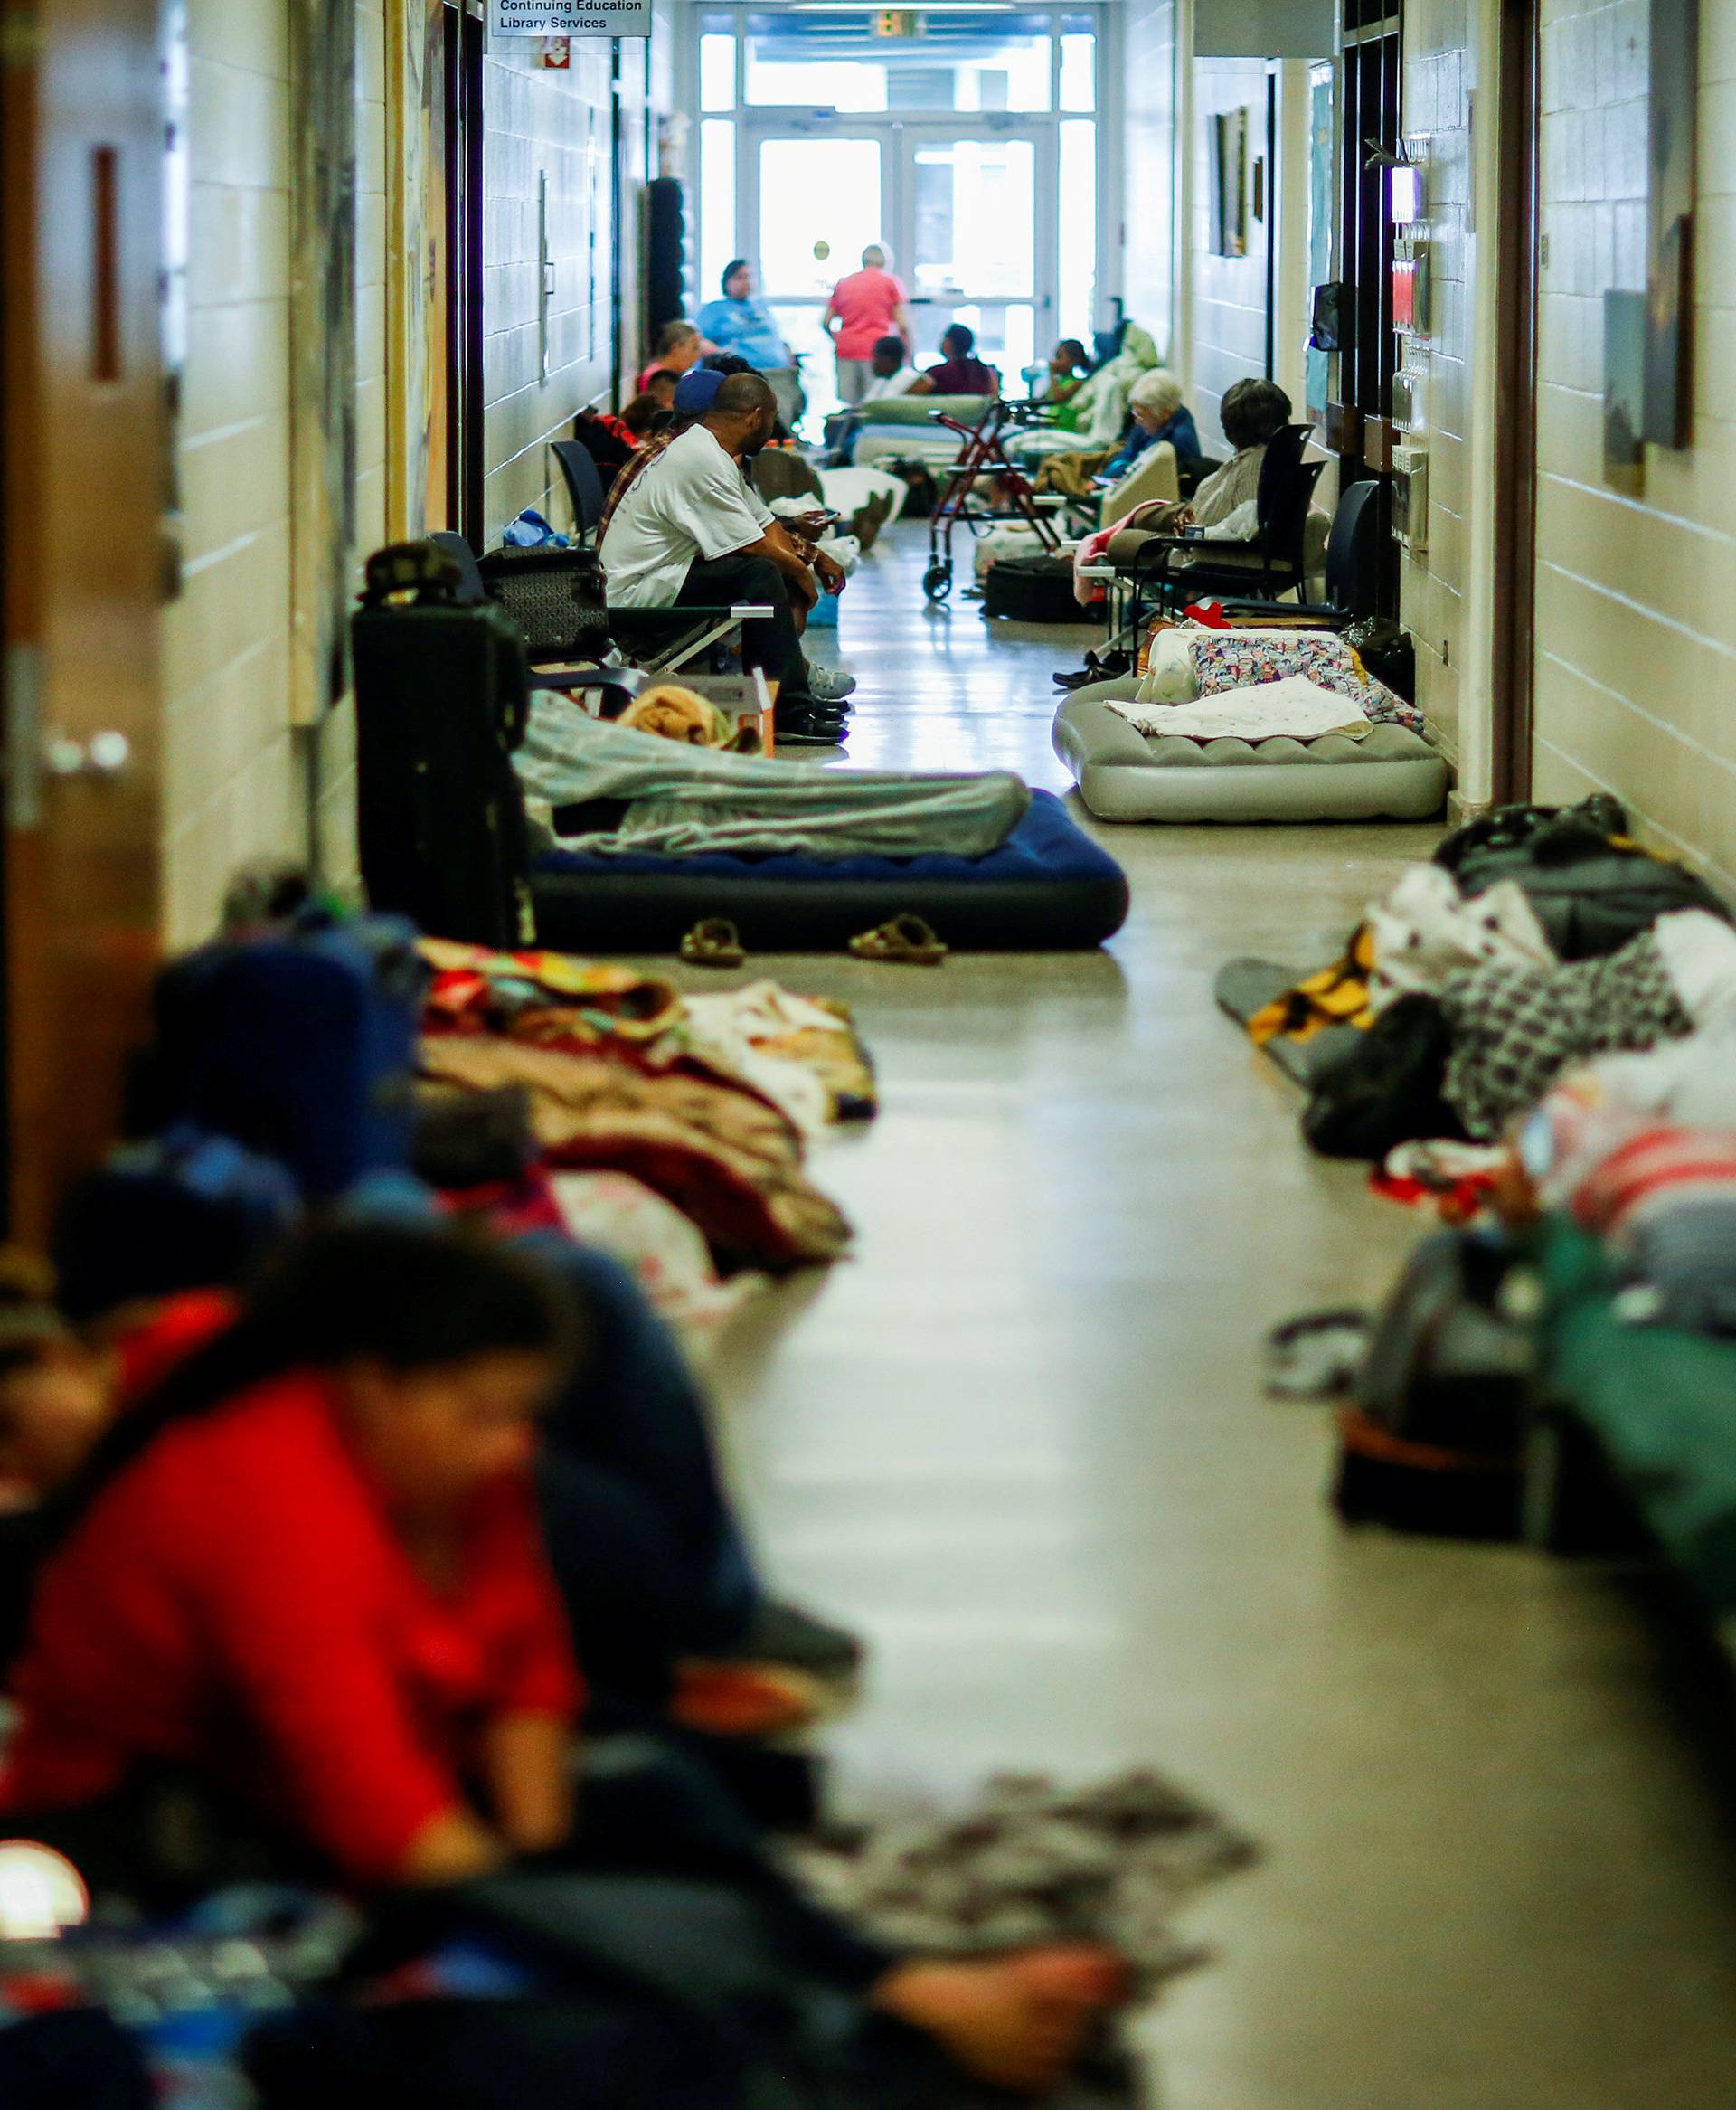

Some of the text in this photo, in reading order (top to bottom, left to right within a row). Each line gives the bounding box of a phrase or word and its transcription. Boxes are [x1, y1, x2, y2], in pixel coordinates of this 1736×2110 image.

[500, 0, 642, 13] Continuing Education
[500, 17, 607, 31] Library Services
